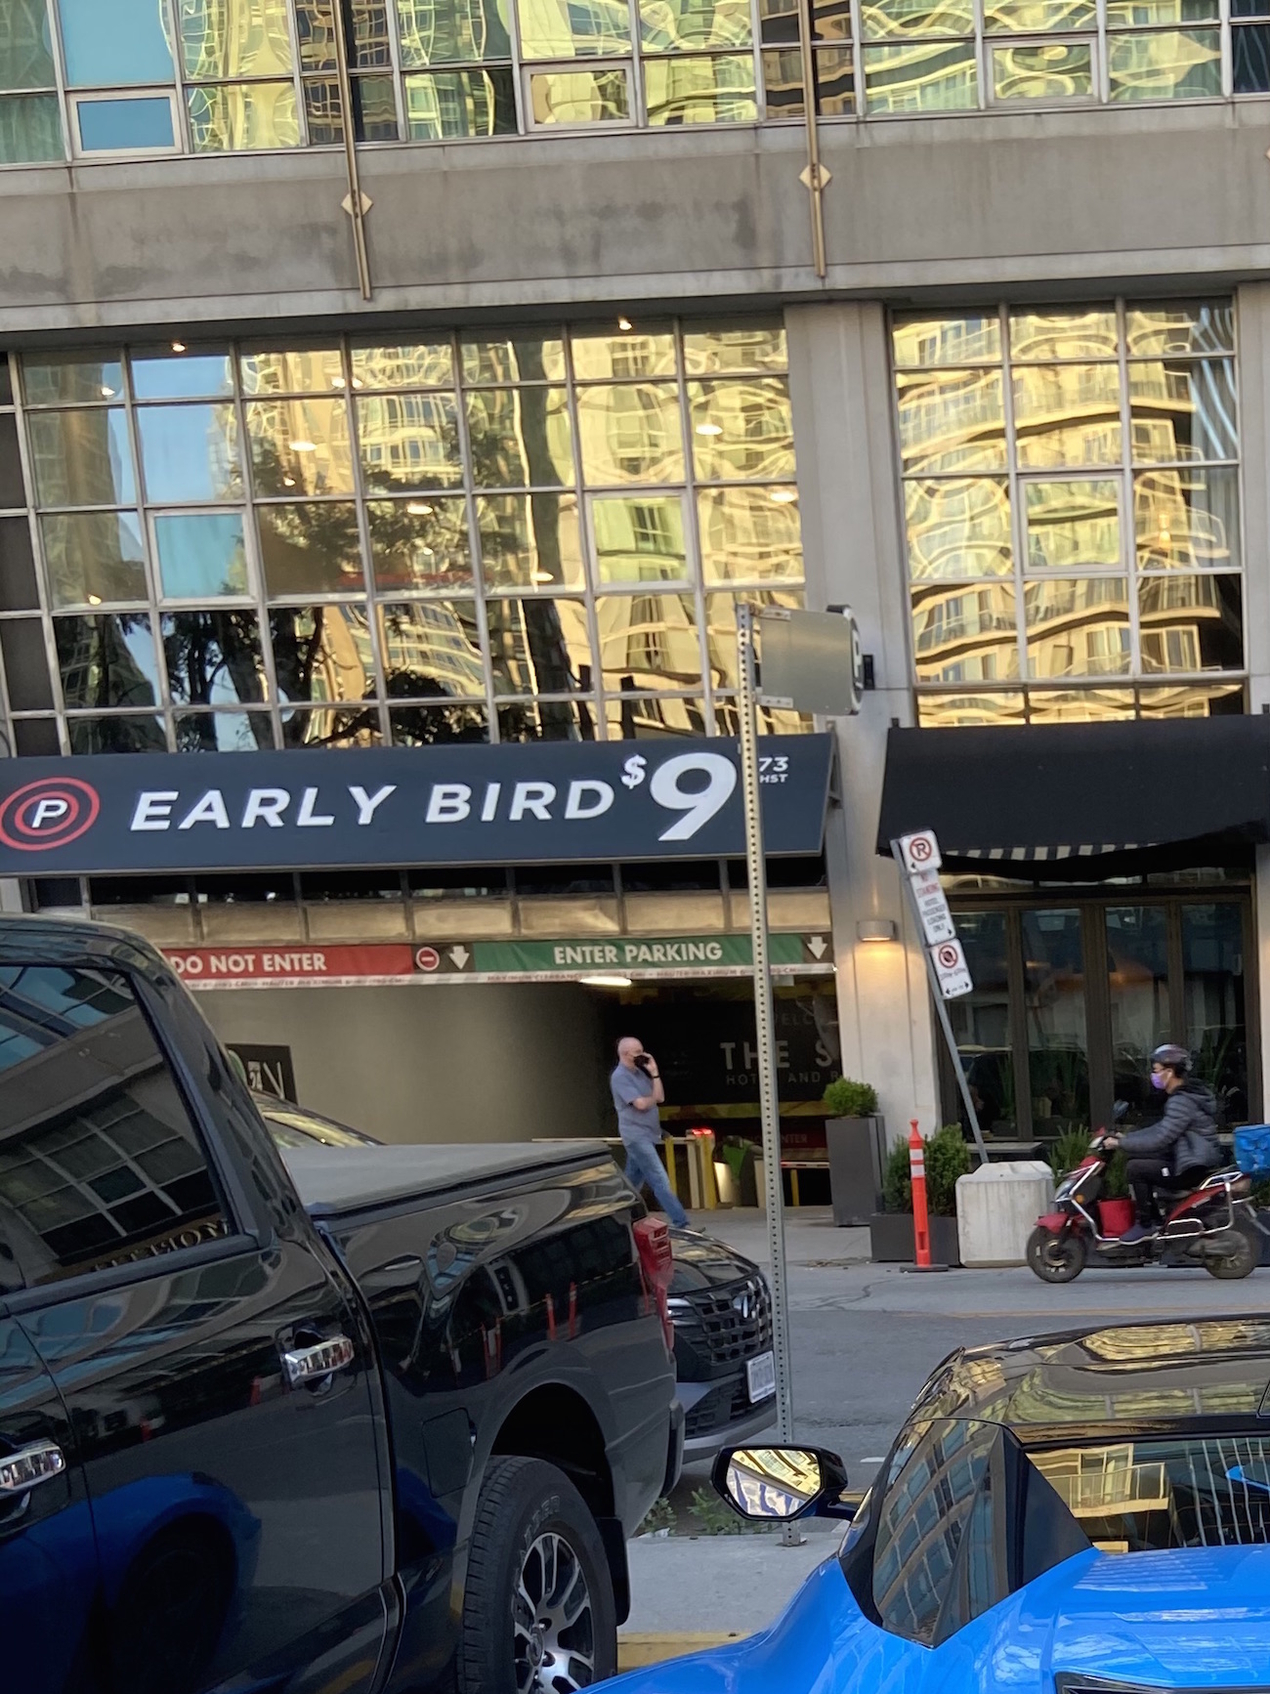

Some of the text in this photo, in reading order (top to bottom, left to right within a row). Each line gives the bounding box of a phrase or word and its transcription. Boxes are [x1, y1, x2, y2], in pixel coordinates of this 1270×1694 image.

[130, 785, 397, 831] EARLY
[425, 779, 615, 823] BIRD
[758, 756, 789, 772] 73
[170, 952, 327, 974] DO NOT ENTER
[554, 942, 723, 964] ENTER PARKING
[719, 1039, 791, 1070] THE
[788, 1071, 821, 1083] AND
